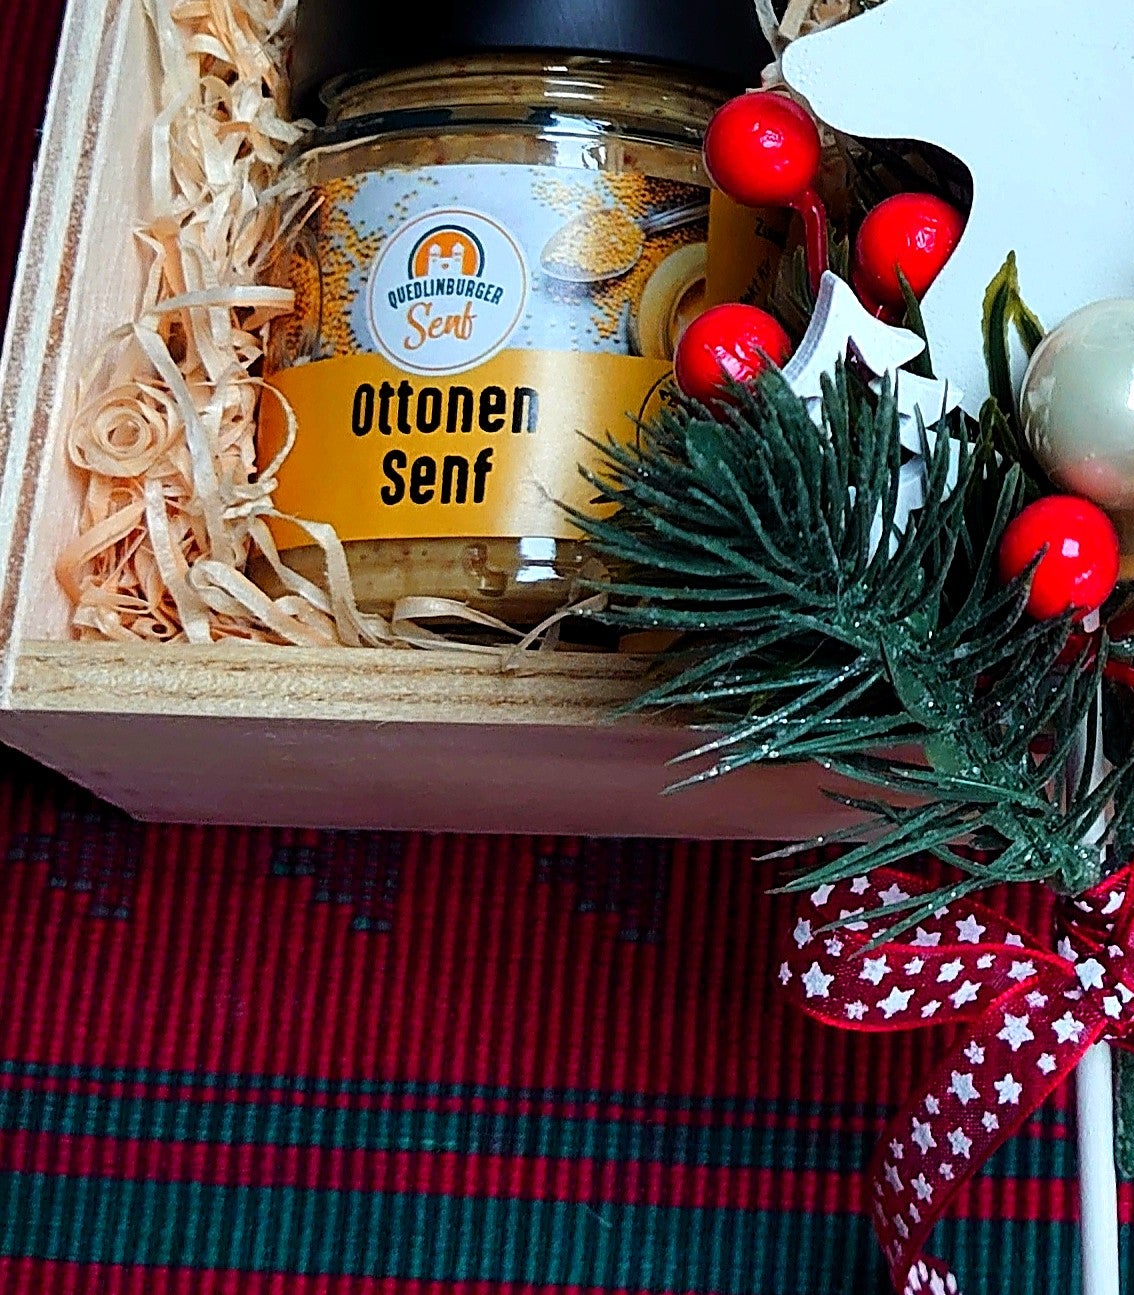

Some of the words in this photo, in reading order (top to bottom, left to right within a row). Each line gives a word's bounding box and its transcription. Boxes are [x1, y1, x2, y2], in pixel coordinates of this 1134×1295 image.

[387, 278, 504, 309] QUEDLINBURGER
[404, 301, 478, 350] Senf
[351, 380, 540, 437] Ottonen
[380, 447, 494, 506] Senf
